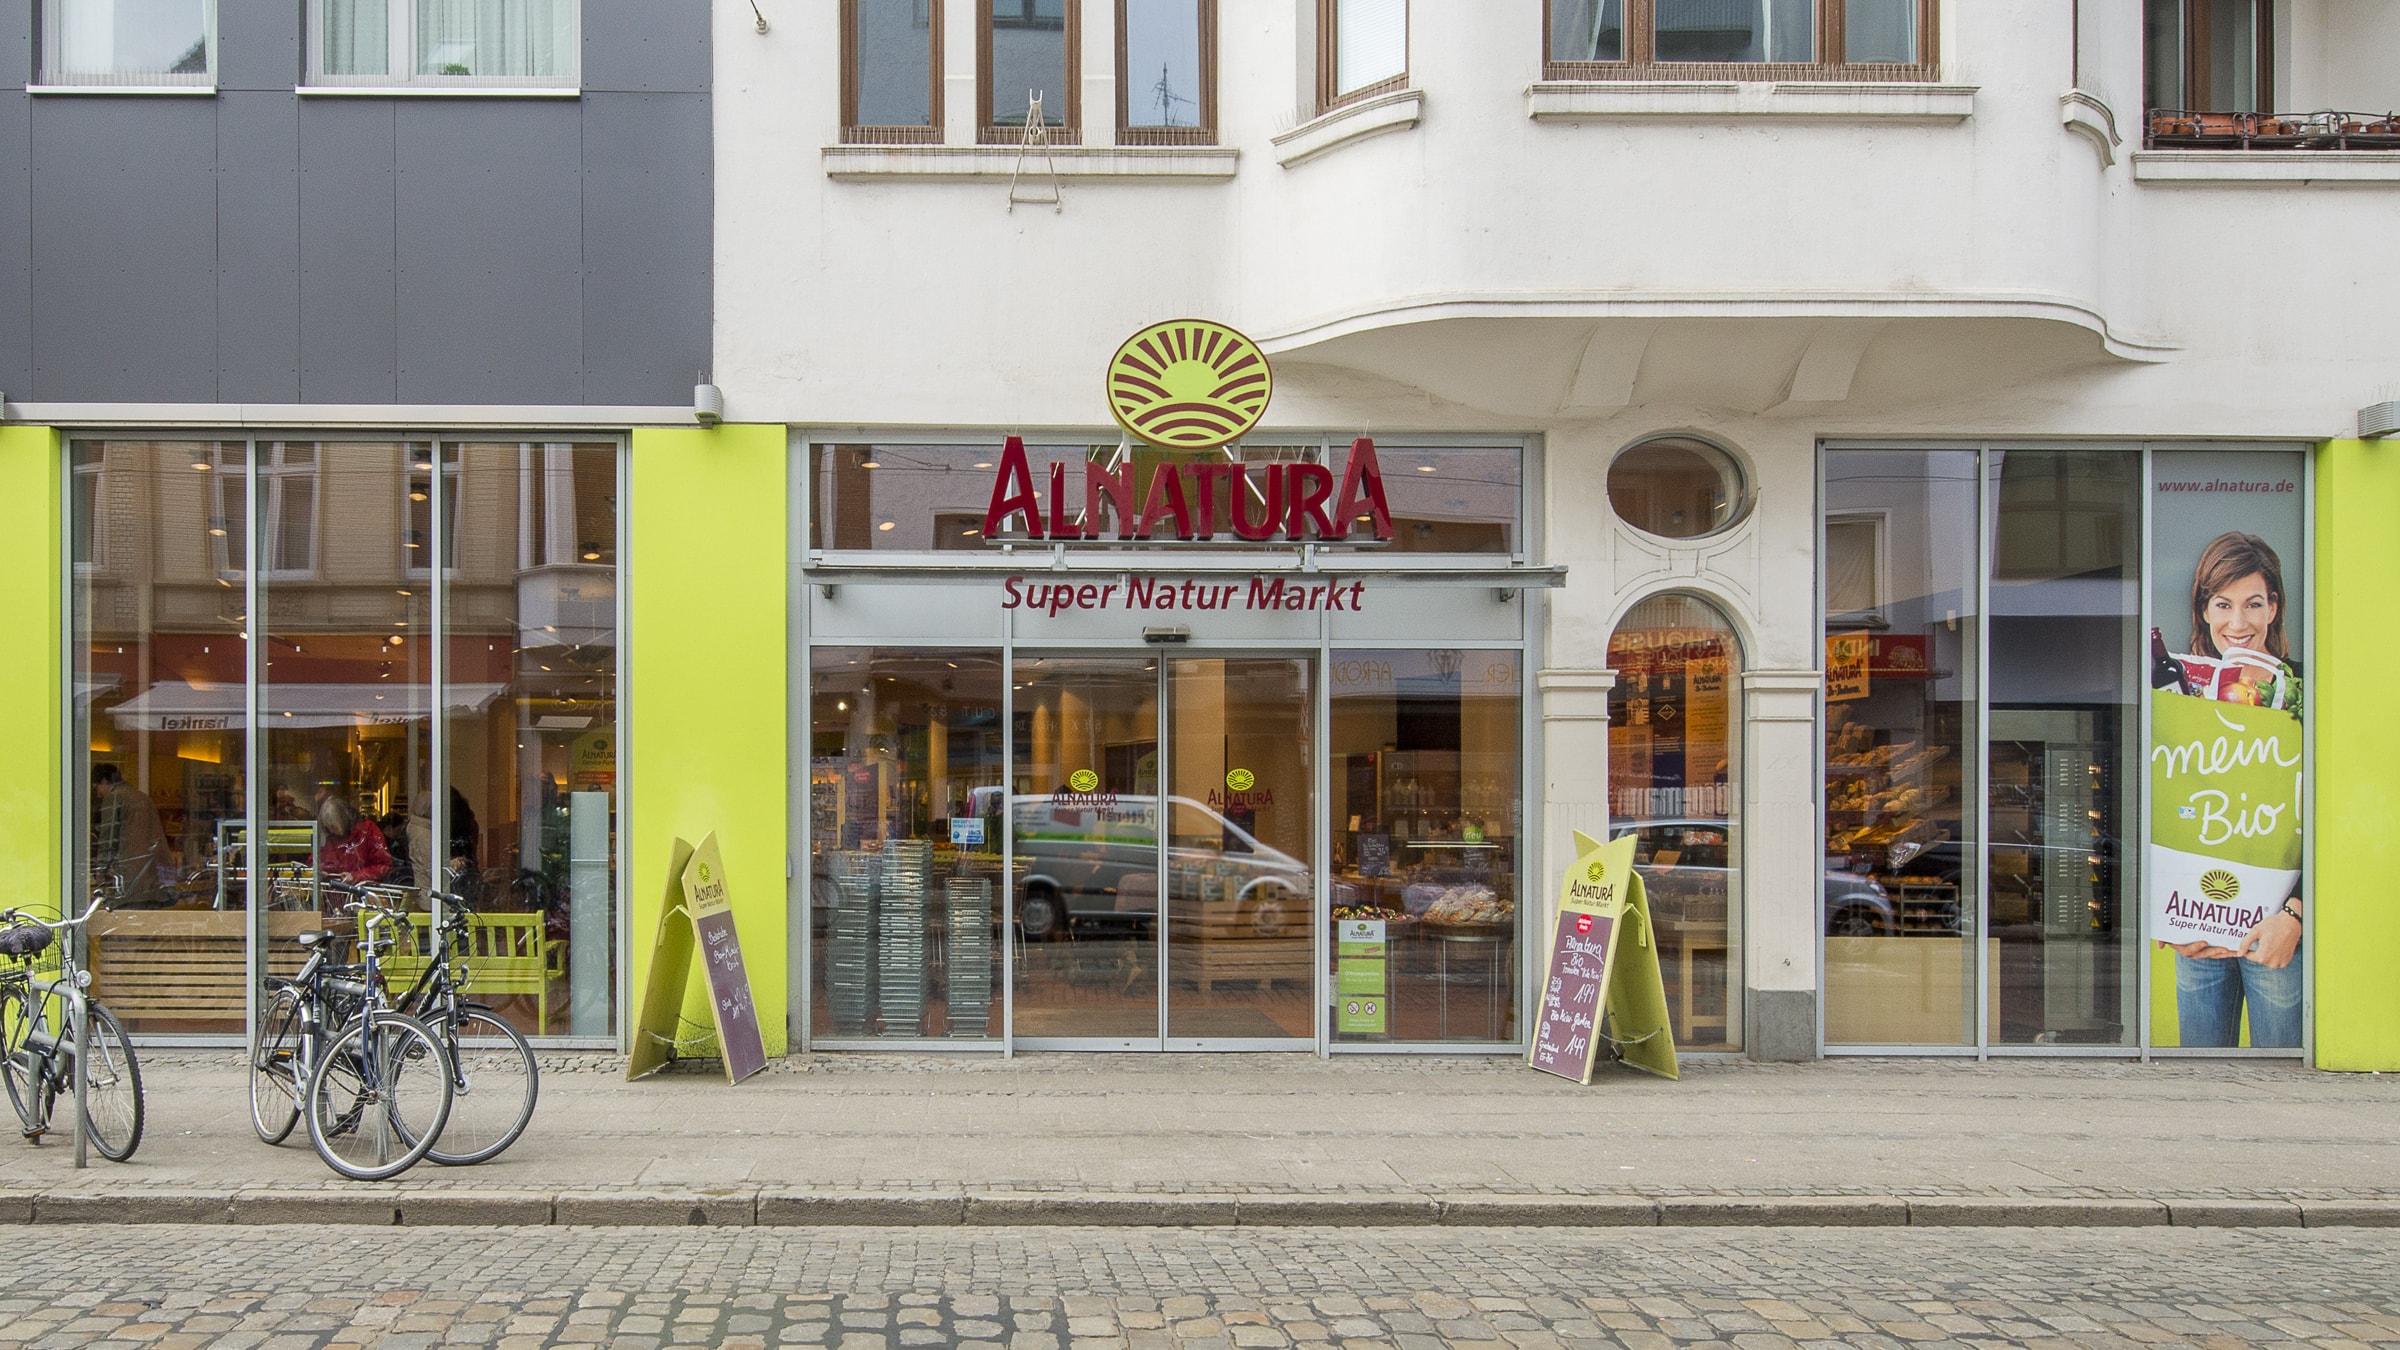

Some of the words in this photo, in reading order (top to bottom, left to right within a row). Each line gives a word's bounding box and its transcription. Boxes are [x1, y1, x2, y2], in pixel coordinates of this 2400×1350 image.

[983, 436, 1394, 540] ALNATURA
[2159, 479, 2294, 493] www.alnatura.de
[1002, 577, 1116, 618] Super
[1126, 577, 1239, 610] Natur
[1246, 577, 1365, 611] Markt
[1051, 787, 1118, 806] ALNATURA
[1208, 788, 1274, 805] ALNATURA
[1466, 832, 1481, 840] neu
[694, 879, 725, 902] ALNATURA
[1570, 879, 1613, 901] ALNATURA
[1571, 897, 1583, 905] Super
[1584, 899, 1595, 907] Natur
[2165, 890, 2264, 929] ALNATURA
[2169, 917, 2197, 931] Super
[2199, 923, 2227, 936] Natur
